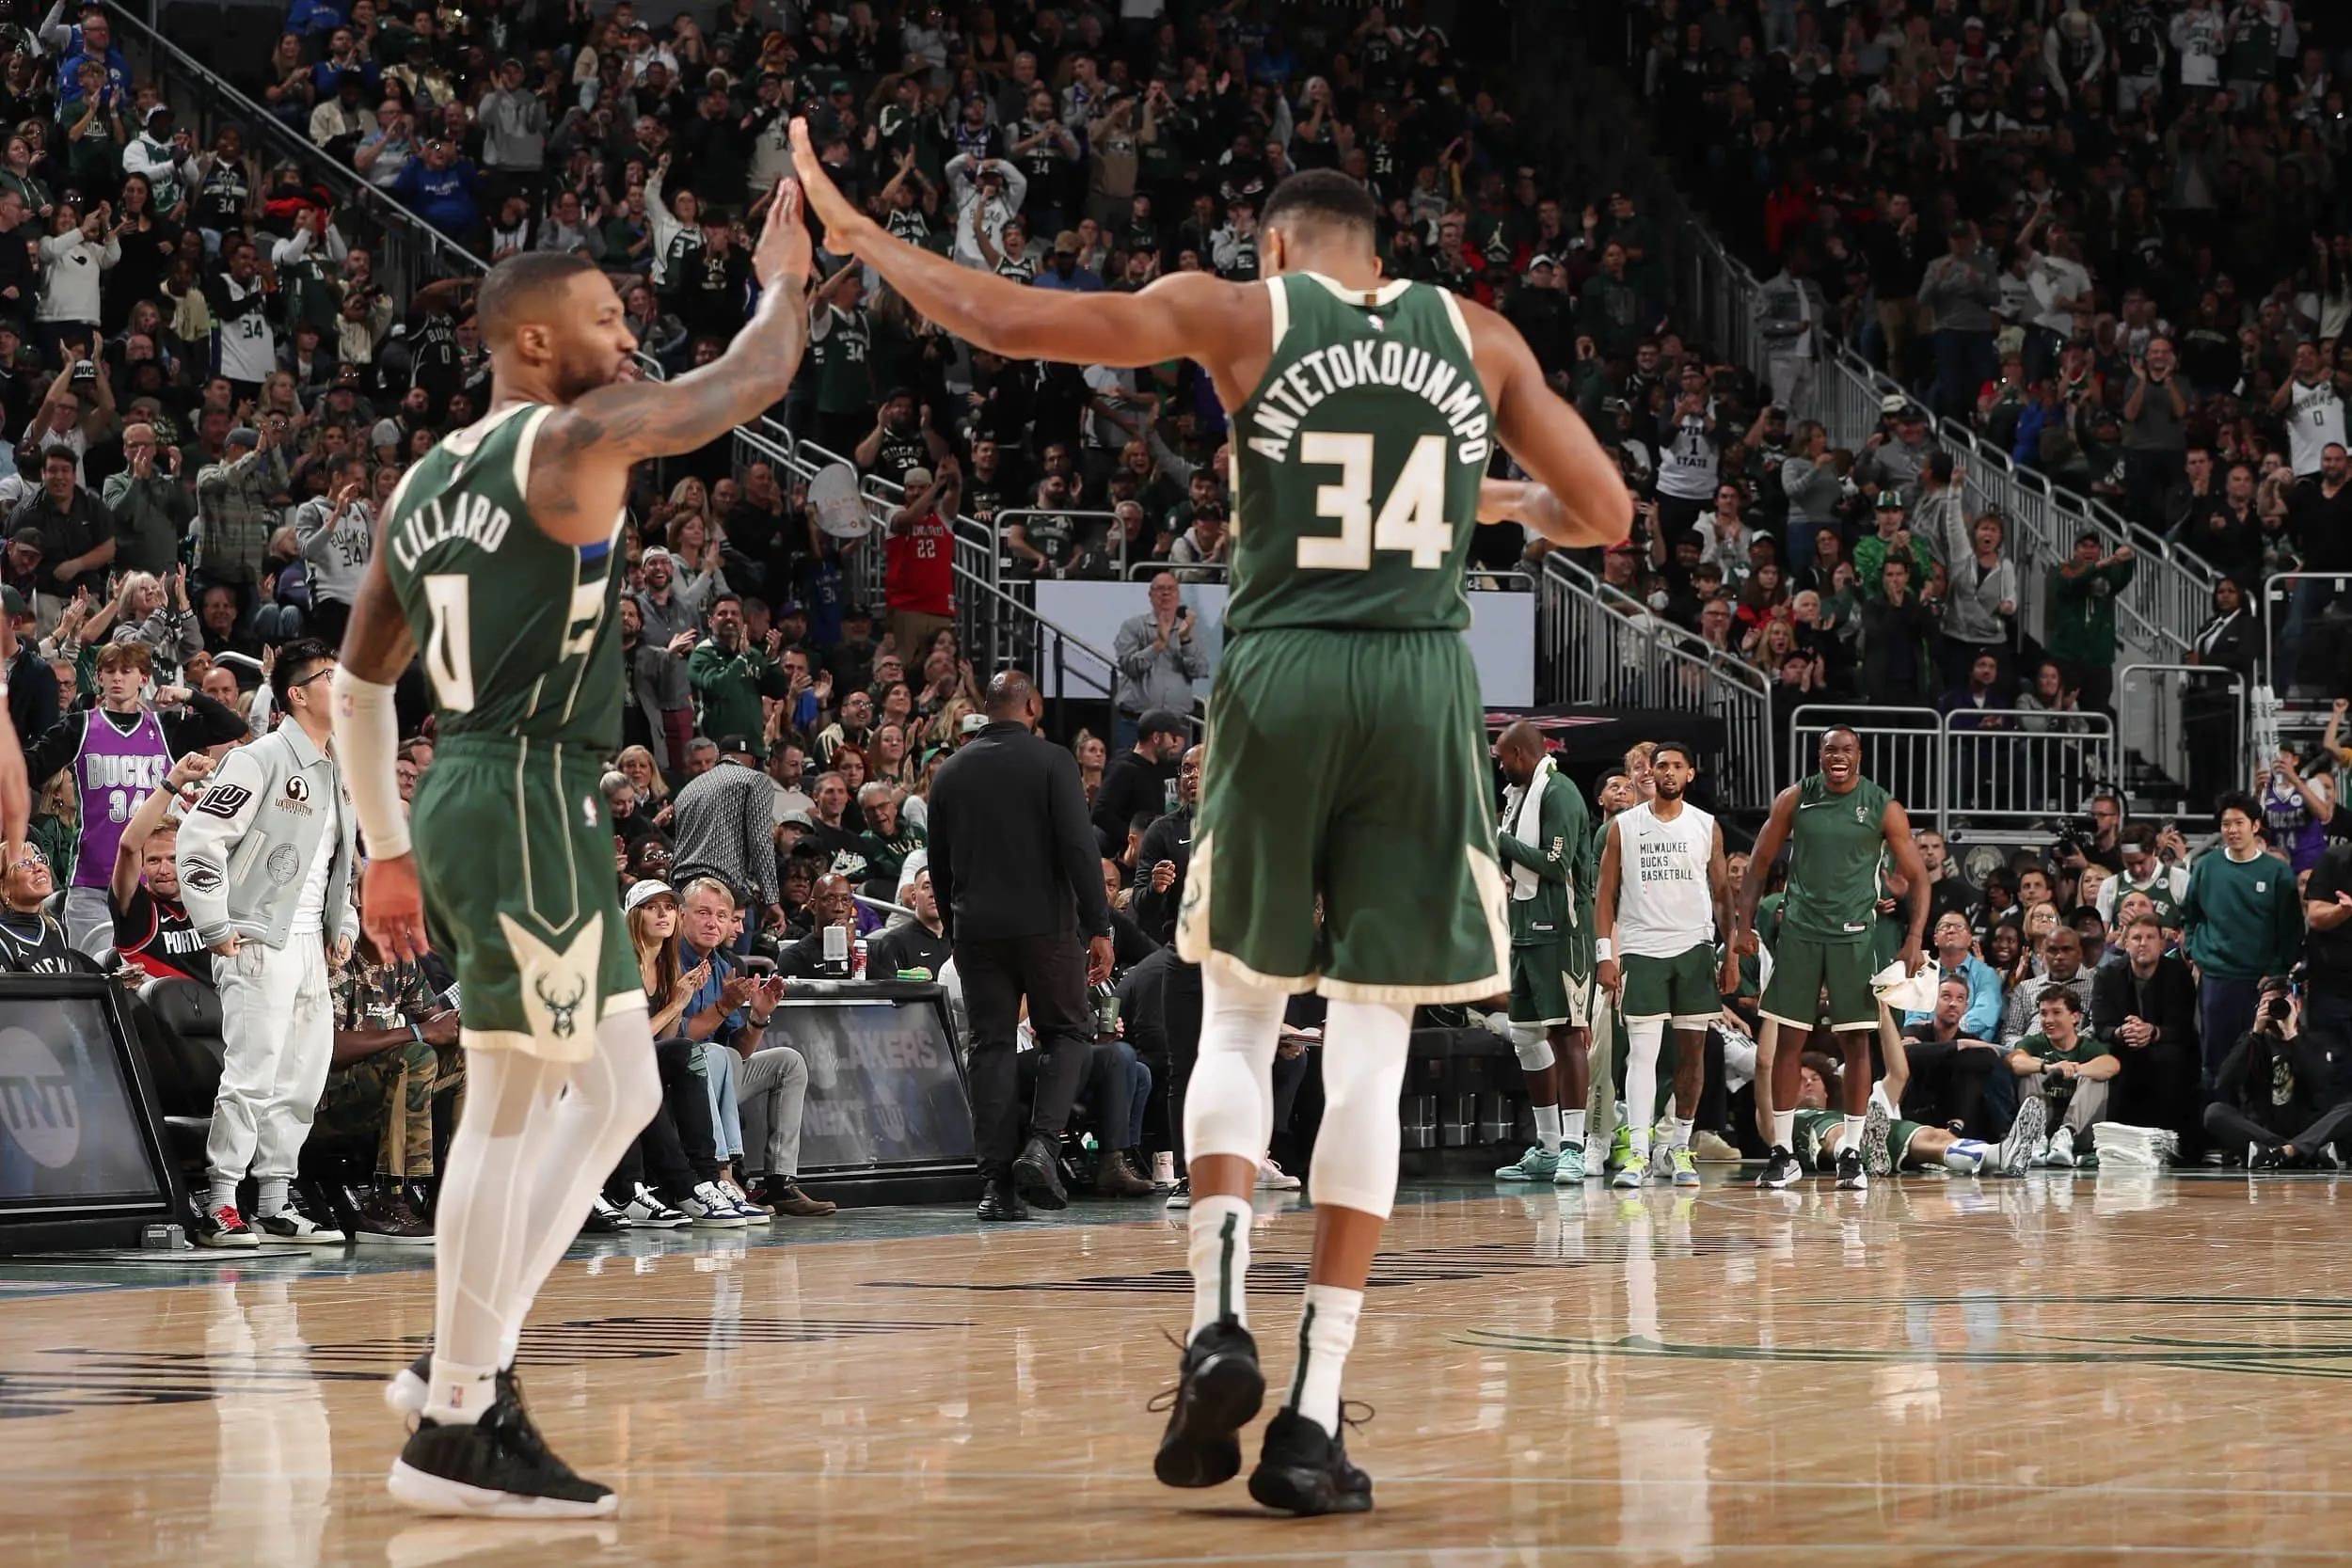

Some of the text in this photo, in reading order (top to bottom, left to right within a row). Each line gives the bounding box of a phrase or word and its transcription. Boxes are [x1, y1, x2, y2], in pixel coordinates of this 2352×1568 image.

[217, 198, 236, 214] 34
[243, 320, 264, 340] 34
[846, 341, 865, 362] 34
[1248, 339, 1489, 466] ANTETOKOUNMPO
[2313, 410, 2325, 427] 0
[1296, 431, 1454, 571] 34
[329, 529, 369, 548] BUCKS
[393, 491, 513, 573] LILLARD
[341, 546, 364, 568] 34
[916, 538, 937, 559] 22
[423, 573, 475, 713] 0
[85, 752, 169, 791] BUCKS
[1640, 842, 1688, 855] MILWAUKEE
[1641, 856, 1670, 868] BUCKS
[1642, 869, 1693, 882] BASKETBALL
[162, 929, 207, 955] PORTL
